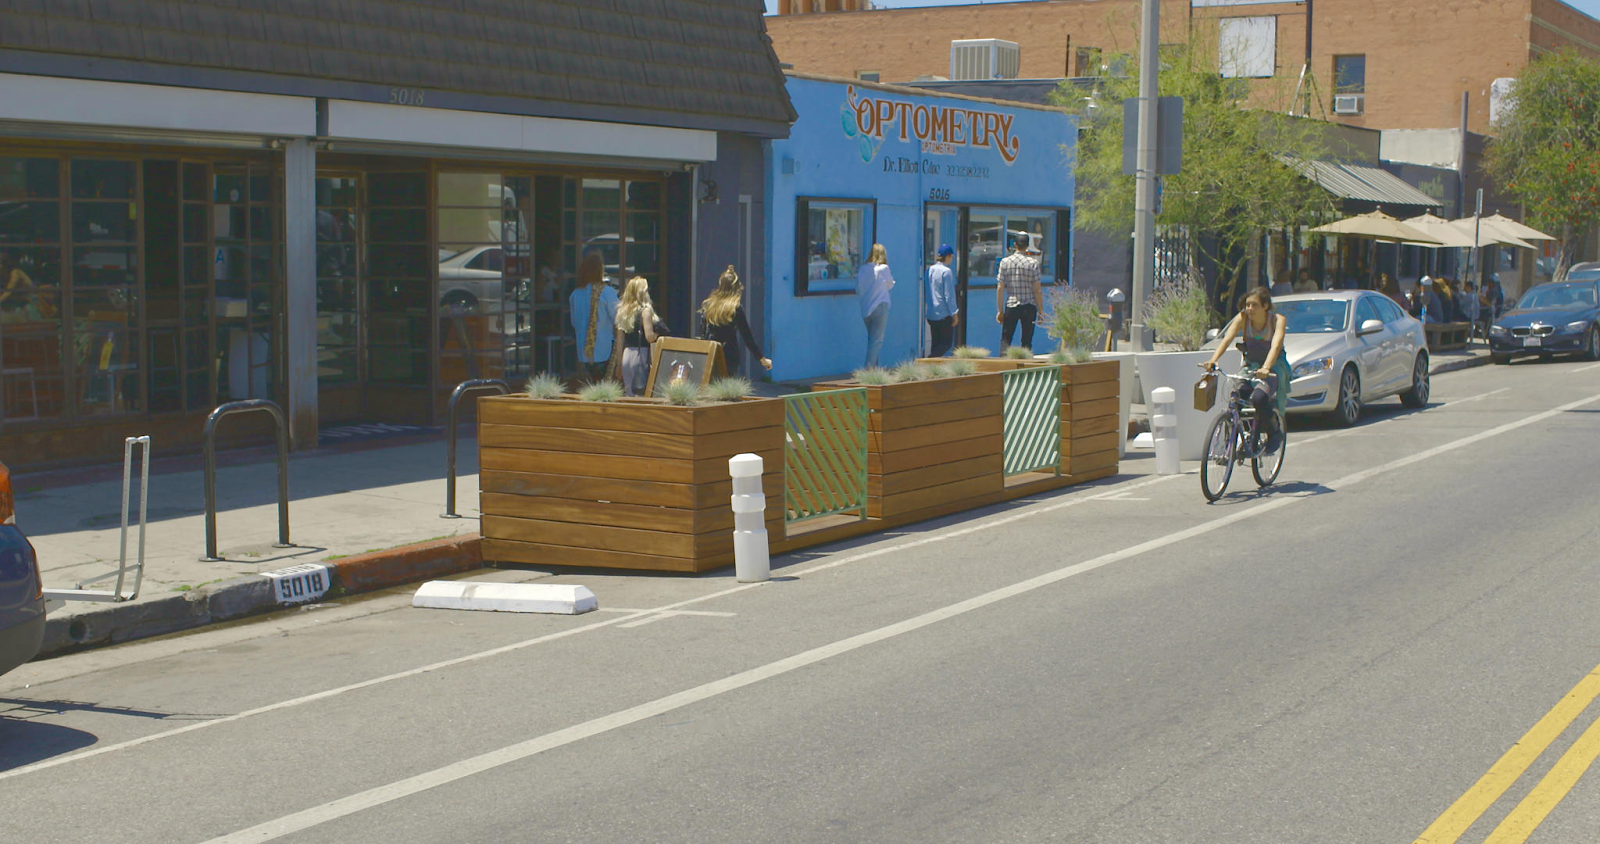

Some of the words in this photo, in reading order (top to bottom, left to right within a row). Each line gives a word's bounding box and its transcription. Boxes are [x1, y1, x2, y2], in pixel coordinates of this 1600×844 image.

[390, 88, 425, 105] 5018
[853, 97, 1019, 163] OPTOMETRY
[883, 156, 897, 172] Dr.
[929, 188, 950, 201] 5016
[214, 249, 226, 265] A
[280, 572, 323, 598] 5018
